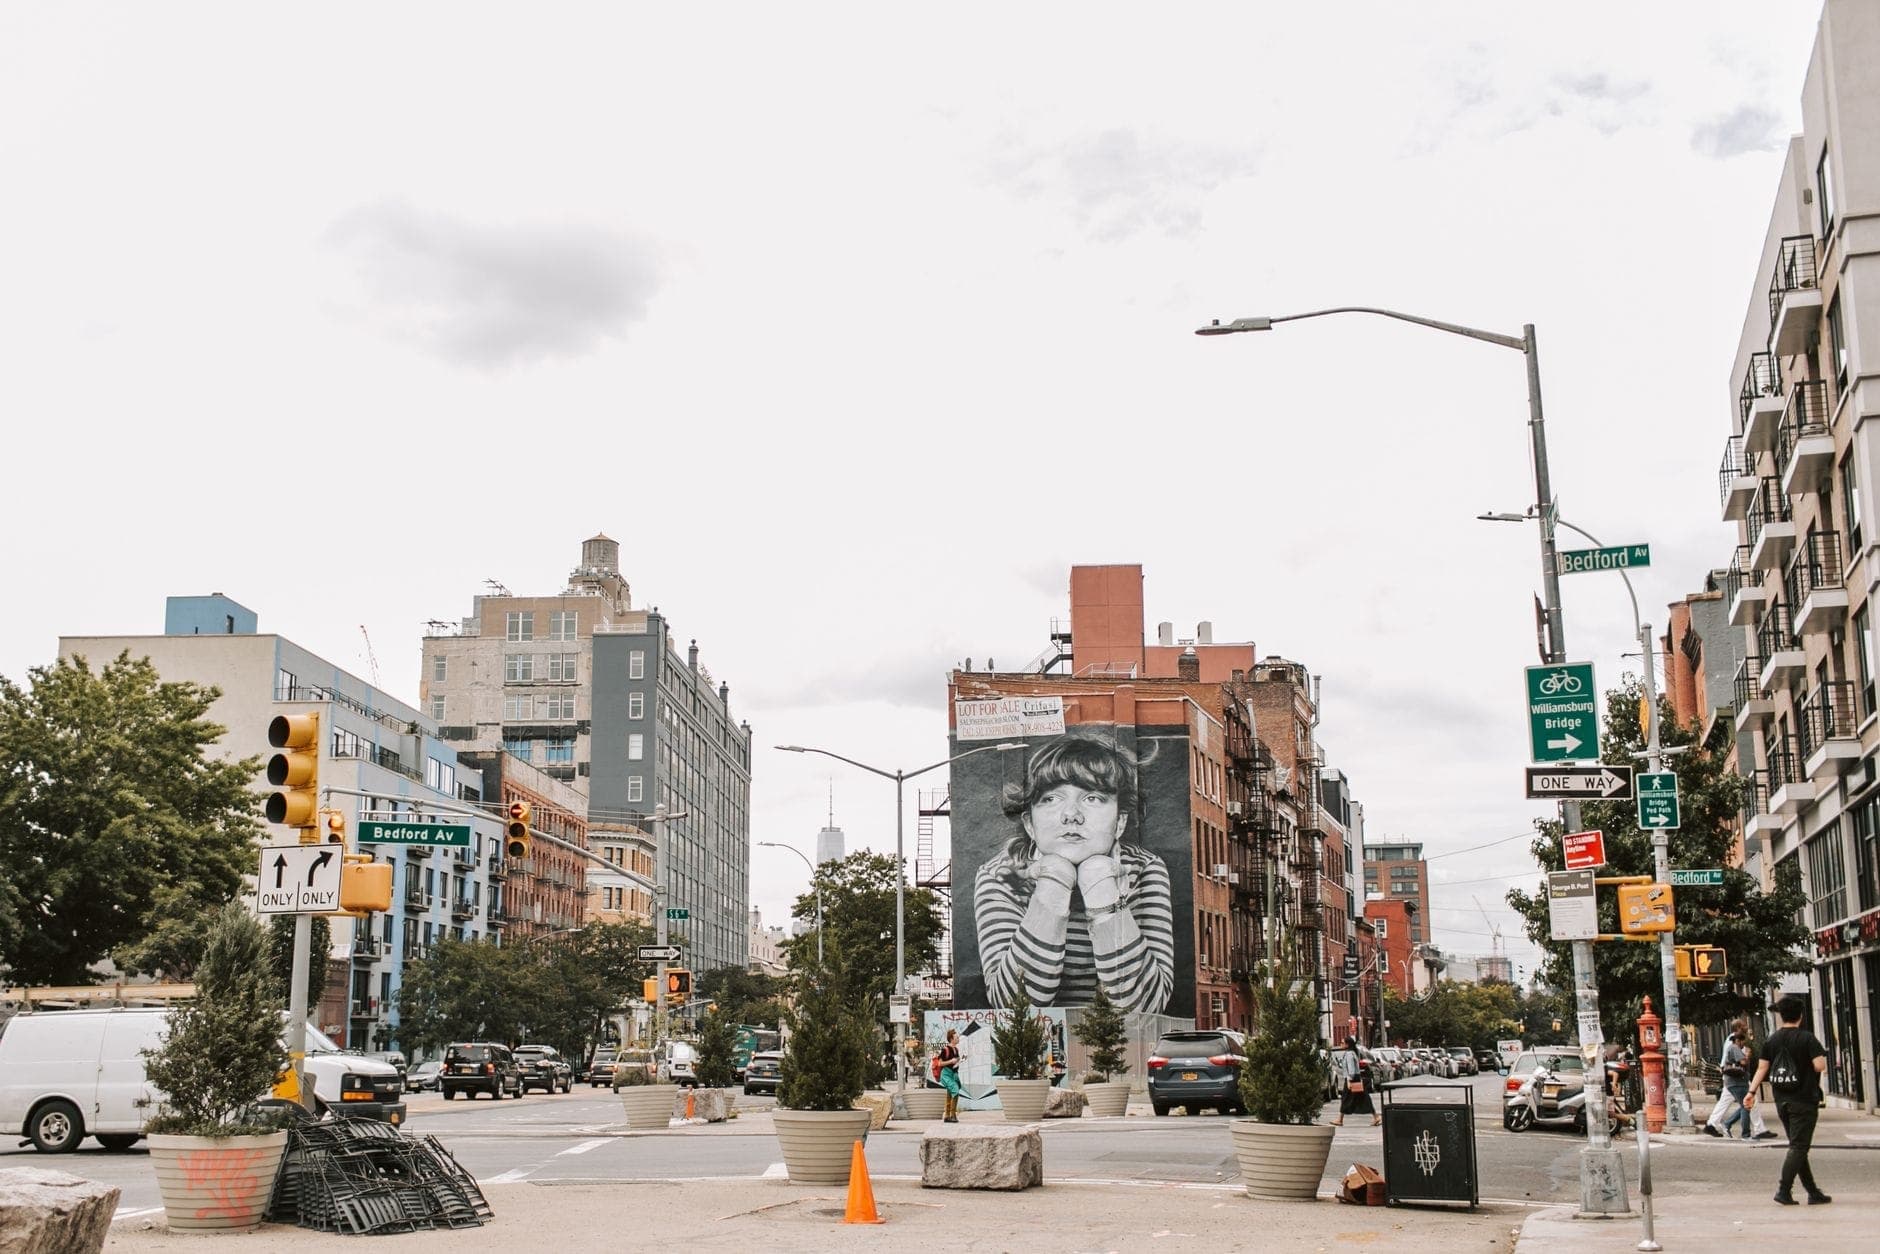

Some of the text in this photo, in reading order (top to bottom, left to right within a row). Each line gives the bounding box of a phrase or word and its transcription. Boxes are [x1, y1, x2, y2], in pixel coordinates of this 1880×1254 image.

[1564, 548, 1648, 572] Bedford Av
[959, 704, 976, 716] LOT
[980, 703, 997, 715] FOR
[1532, 701, 1593, 714] Williamsburg
[1545, 717, 1581, 729] Bridge
[1541, 776, 1615, 789] ONE WAY
[374, 826, 454, 842] Bedford Av
[1672, 872, 1710, 884] Bedford
[263, 892, 335, 906] ONLY ONLY
[1769, 1075, 1797, 1083] TIDAL
